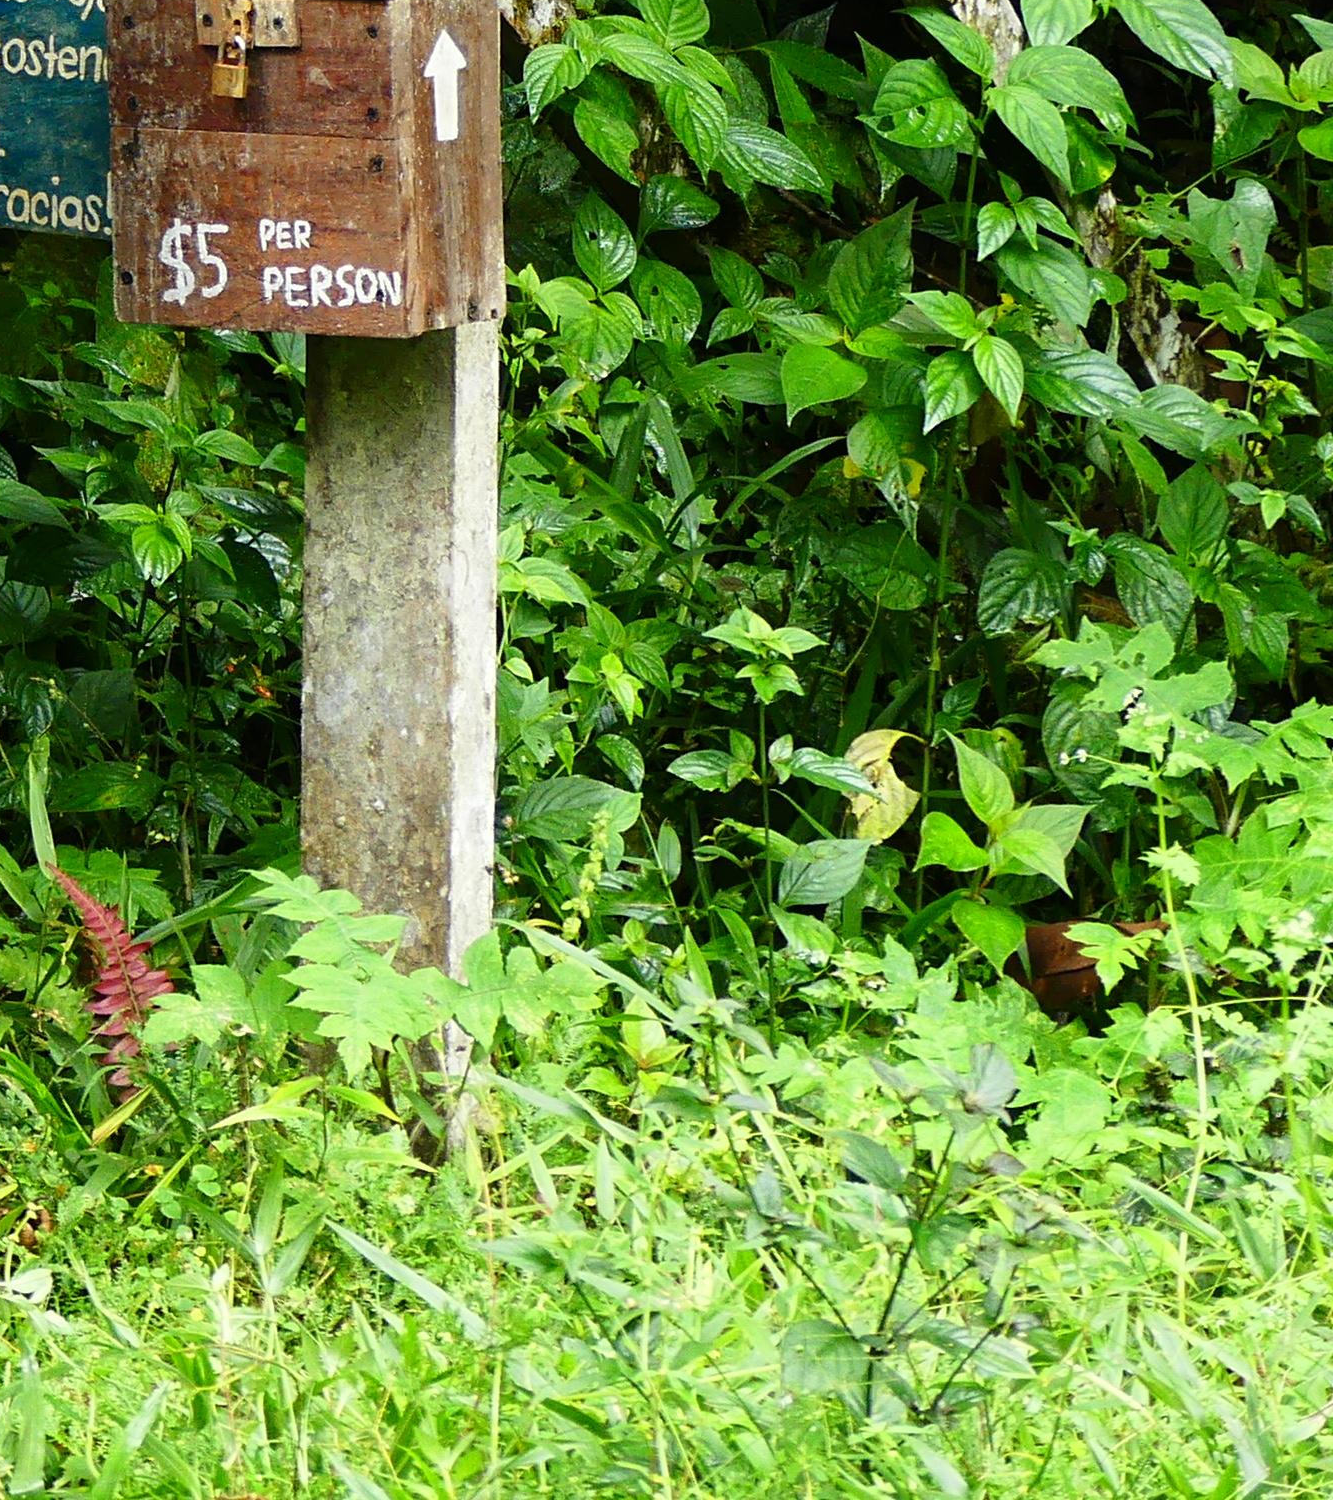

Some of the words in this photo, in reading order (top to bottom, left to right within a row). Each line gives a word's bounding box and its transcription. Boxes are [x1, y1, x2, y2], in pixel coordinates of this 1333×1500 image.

[158, 217, 230, 307] $5
[259, 219, 313, 252] PER
[263, 264, 403, 308] PERSON
